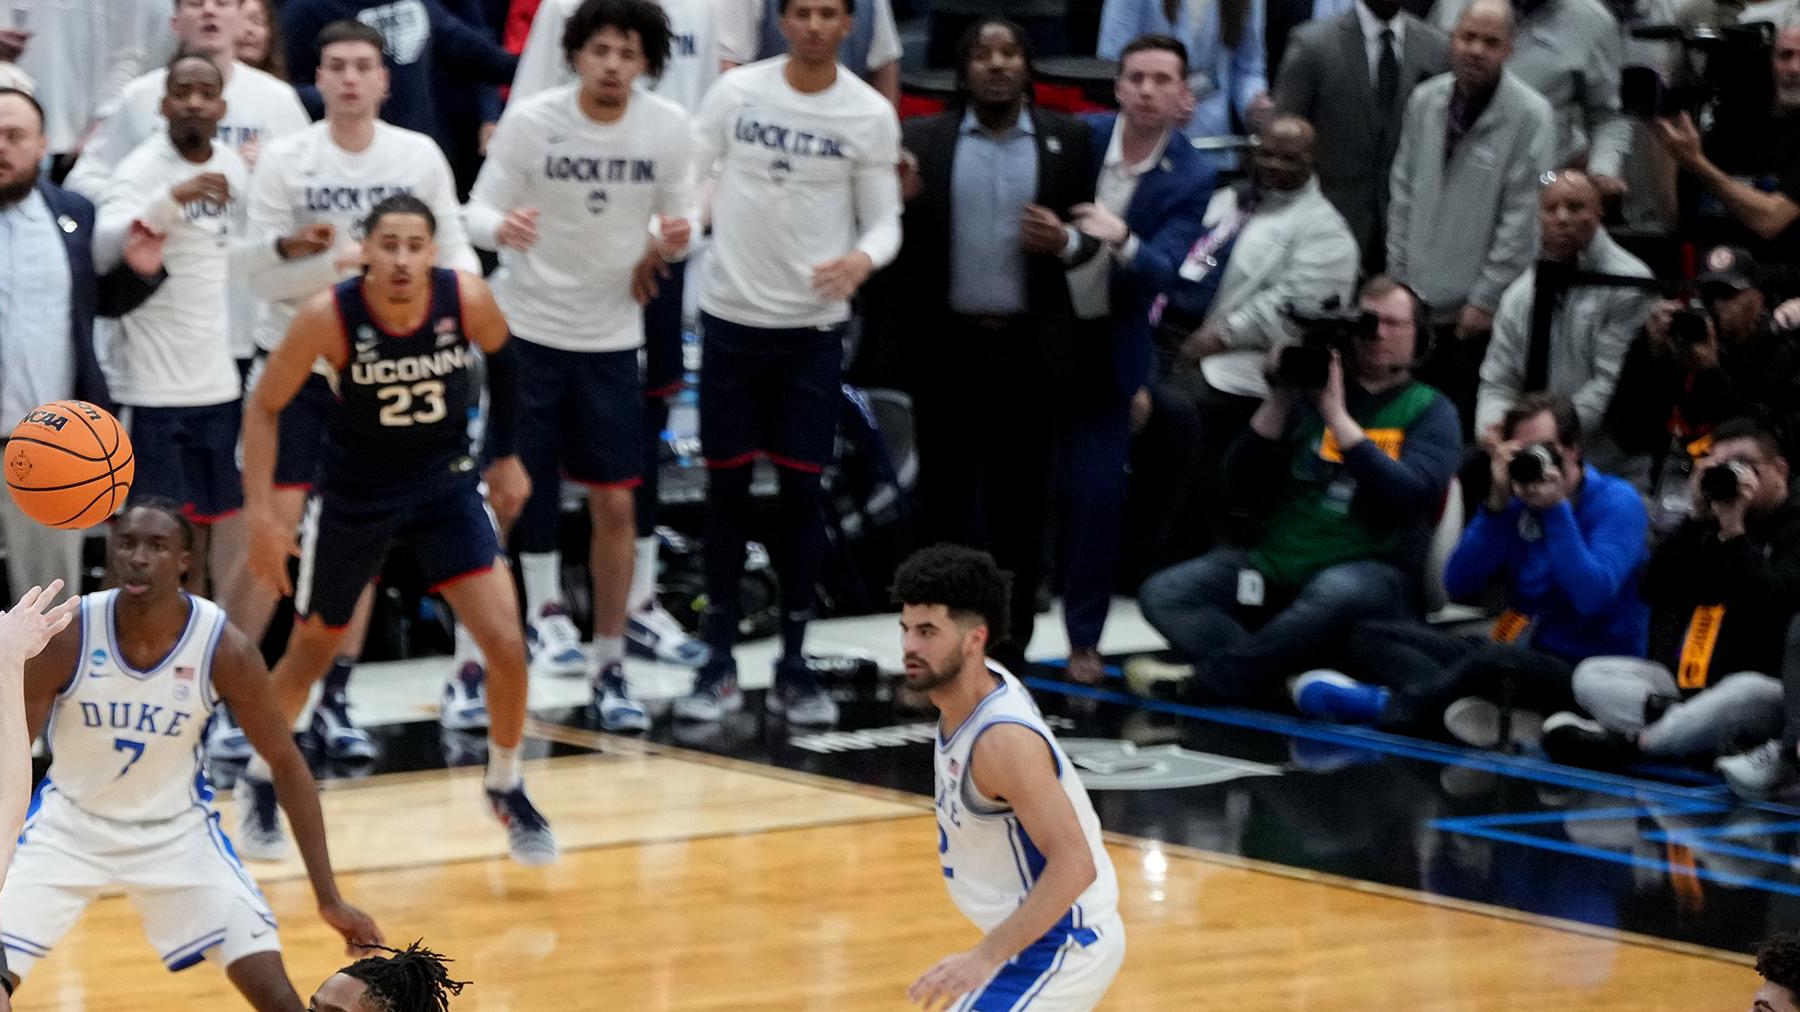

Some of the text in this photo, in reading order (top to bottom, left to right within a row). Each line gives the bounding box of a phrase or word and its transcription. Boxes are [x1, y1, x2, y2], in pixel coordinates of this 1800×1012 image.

[545, 156, 600, 182] LOCK
[352, 345, 465, 384] UCONN
[377, 380, 448, 426] 23
[79, 702, 191, 736] DUKE
[113, 737, 146, 782] 7
